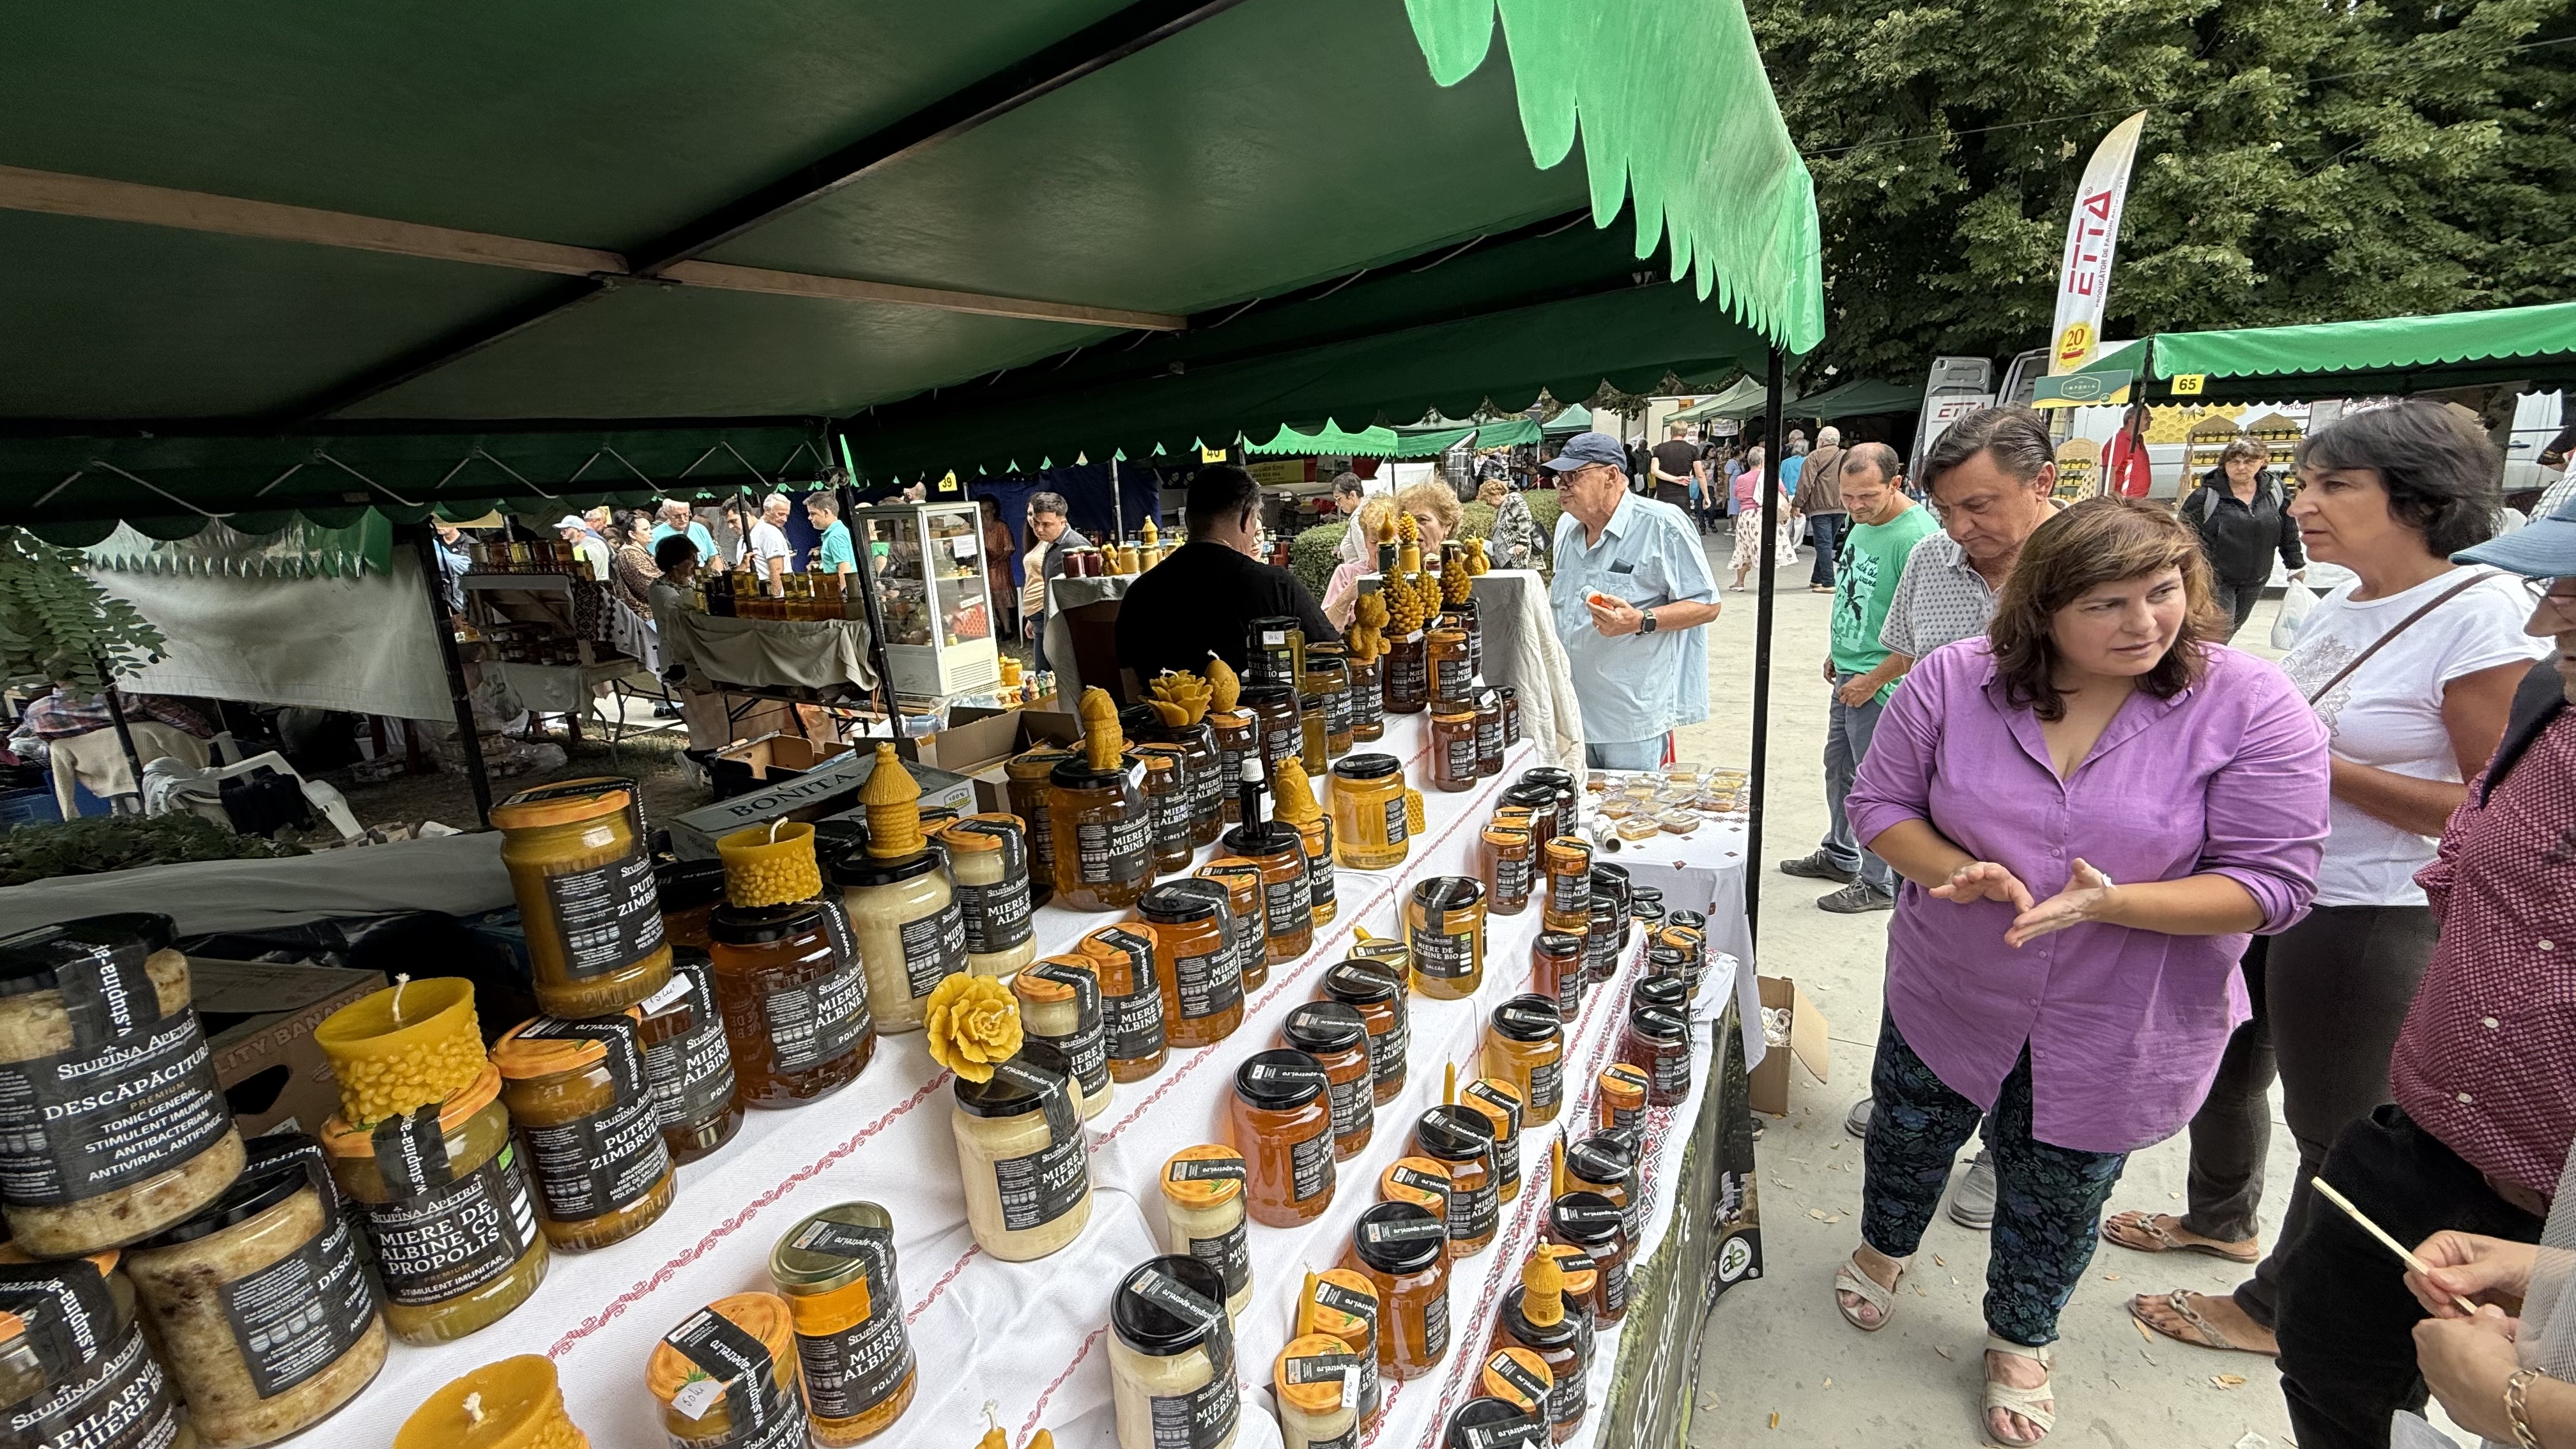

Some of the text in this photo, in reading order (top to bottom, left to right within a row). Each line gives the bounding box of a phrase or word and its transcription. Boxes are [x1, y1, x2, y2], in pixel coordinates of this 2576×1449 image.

[2066, 328, 2085, 348] 20
[2179, 378, 2197, 390] 65
[942, 477, 952, 488] 39
[726, 772, 857, 817] BONITA
[1108, 840, 1144, 857] ALBINE
[1113, 831, 1142, 847] MIERE
[988, 896, 1023, 917] MIERE
[1417, 941, 1439, 953] MIERE
[1212, 956, 1238, 978] MIERE
[815, 995, 862, 1029] ALBINE
[818, 987, 858, 1015] MIERE
[1121, 1005, 1155, 1023] MIERE
[1117, 1016, 1158, 1034] ALBINE
[215, 1037, 267, 1075] LITY
[686, 1033, 726, 1071] MIERE
[101, 1089, 201, 1134] TONIC GENERAL
[130, 1081, 186, 1110] PREMIUM
[85, 1089, 215, 1154] STIMULENT IMUNITAR
[114, 1110, 210, 1160] ANTIBACTERIAN
[1042, 1153, 1078, 1184] MIERE
[427, 1181, 484, 1214] APETREI
[379, 1198, 491, 1246] MIERE DE
[381, 1208, 500, 1261] ALBINE CU
[388, 1228, 500, 1275] PROPOLIS
[401, 1279, 453, 1296] STIMULENT
[843, 1333, 901, 1382] ALBINE
[850, 1320, 898, 1367] MIERE
[11, 1378, 98, 1432] STUPINA
[1196, 1385, 1230, 1422] MIERE
